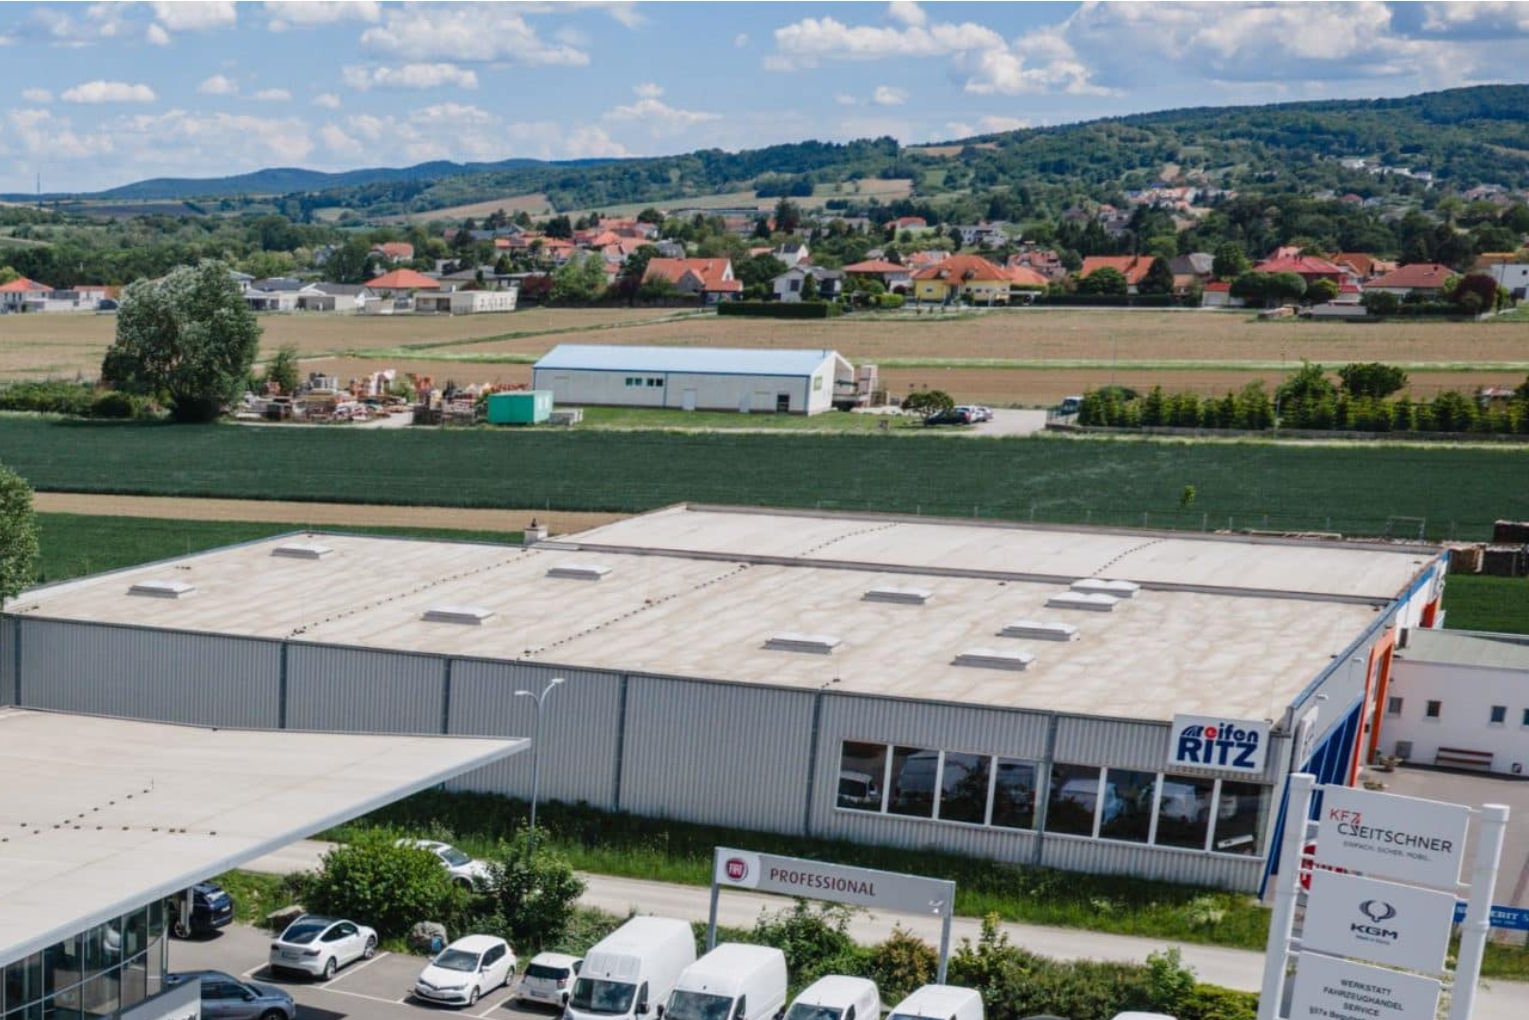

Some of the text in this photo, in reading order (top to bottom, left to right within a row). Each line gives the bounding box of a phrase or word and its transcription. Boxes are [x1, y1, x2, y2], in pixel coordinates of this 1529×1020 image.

[1194, 722, 1259, 743] reifen
[1176, 737, 1258, 769] RITZ
[770, 867, 876, 896] PROFESSIONAL
[1349, 922, 1399, 940] KGM
[1322, 985, 1404, 1010] FAHRZEUGHANDEL
[1339, 978, 1391, 996] WERKSTATT
[1342, 1002, 1380, 1016] SERVICE
